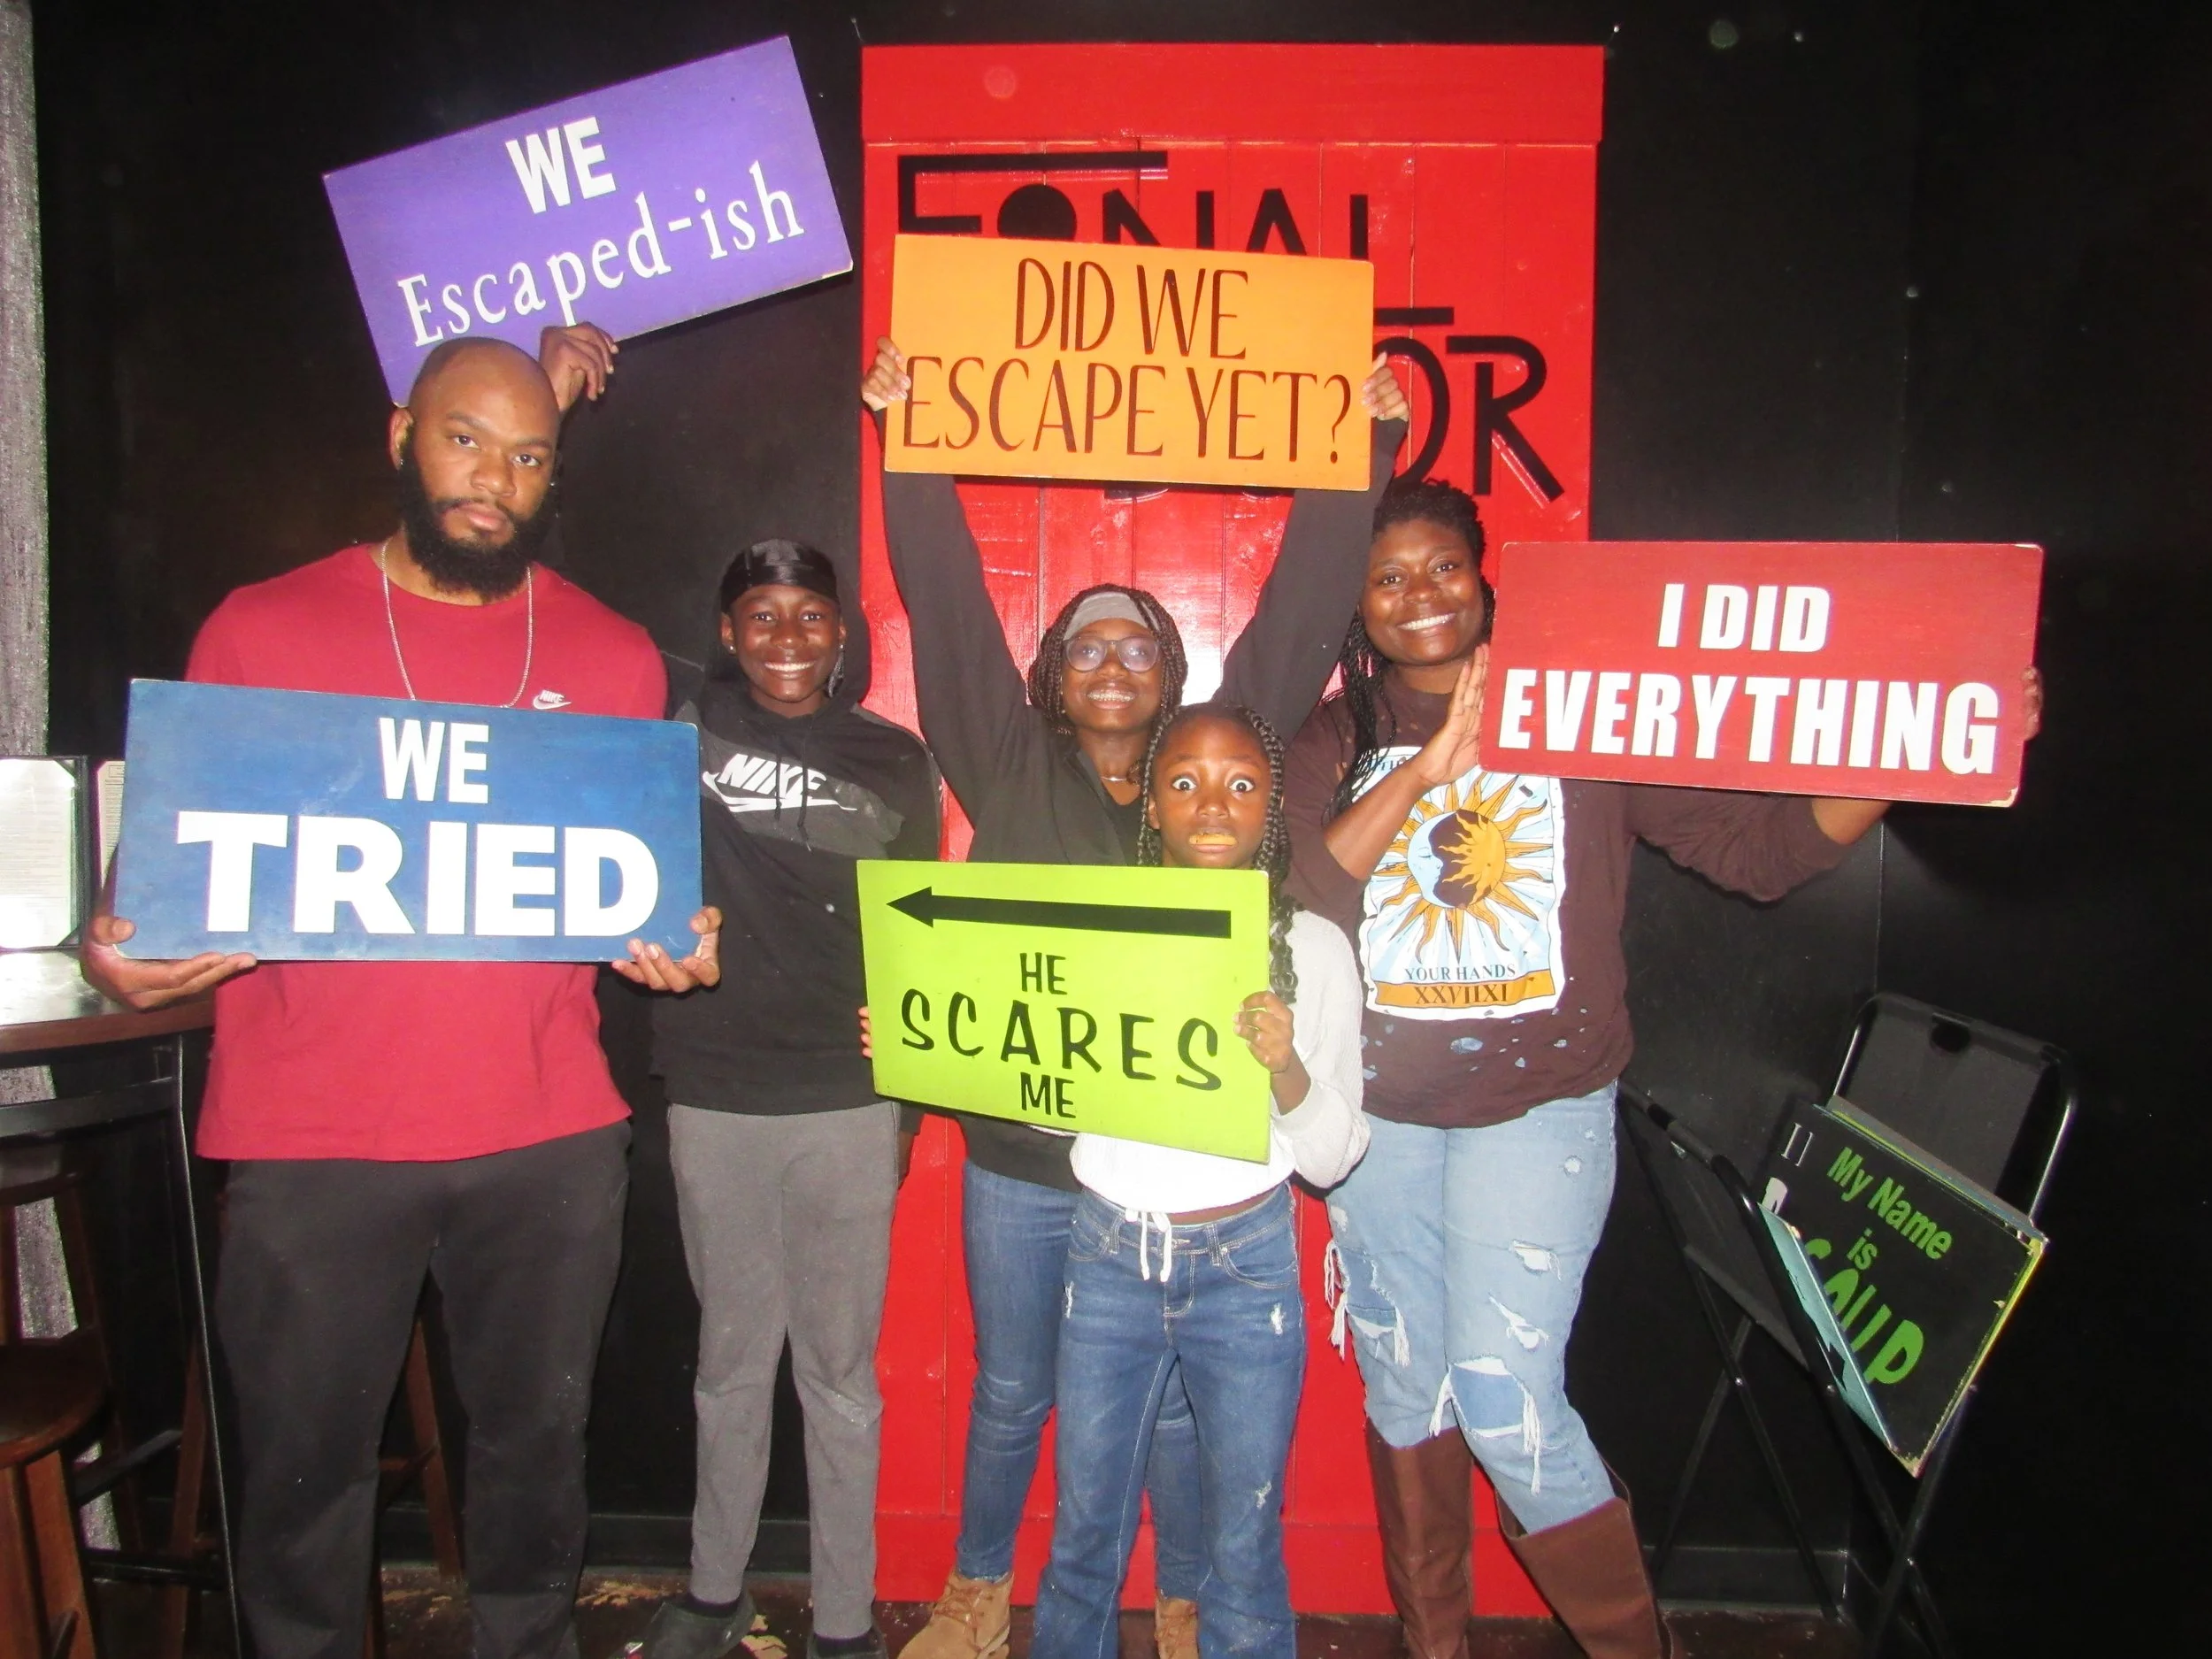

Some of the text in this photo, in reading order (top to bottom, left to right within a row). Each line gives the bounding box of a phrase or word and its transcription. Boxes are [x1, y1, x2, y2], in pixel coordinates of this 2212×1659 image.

[506, 116, 617, 214] WE
[398, 160, 804, 347] Escaped-ish
[1014, 257, 1249, 359] DID WE
[903, 356, 1352, 465] ESCAPE YET?
[1658, 583, 1830, 653] I DID
[539, 689, 565, 704] NIKE
[1498, 668, 2000, 775] EVERYTHING
[379, 717, 490, 804] WE
[717, 753, 827, 802] NIKE
[177, 810, 659, 937] TRIED
[1020, 952, 1068, 995] HE
[1404, 964, 1516, 981] YOUR HANDS
[901, 988, 1222, 1091] SCARES
[1020, 1071, 1077, 1119] ME
[1825, 1147, 1874, 1202] My
[1867, 1177, 1954, 1260] Name
[1847, 1228, 1879, 1271] is
